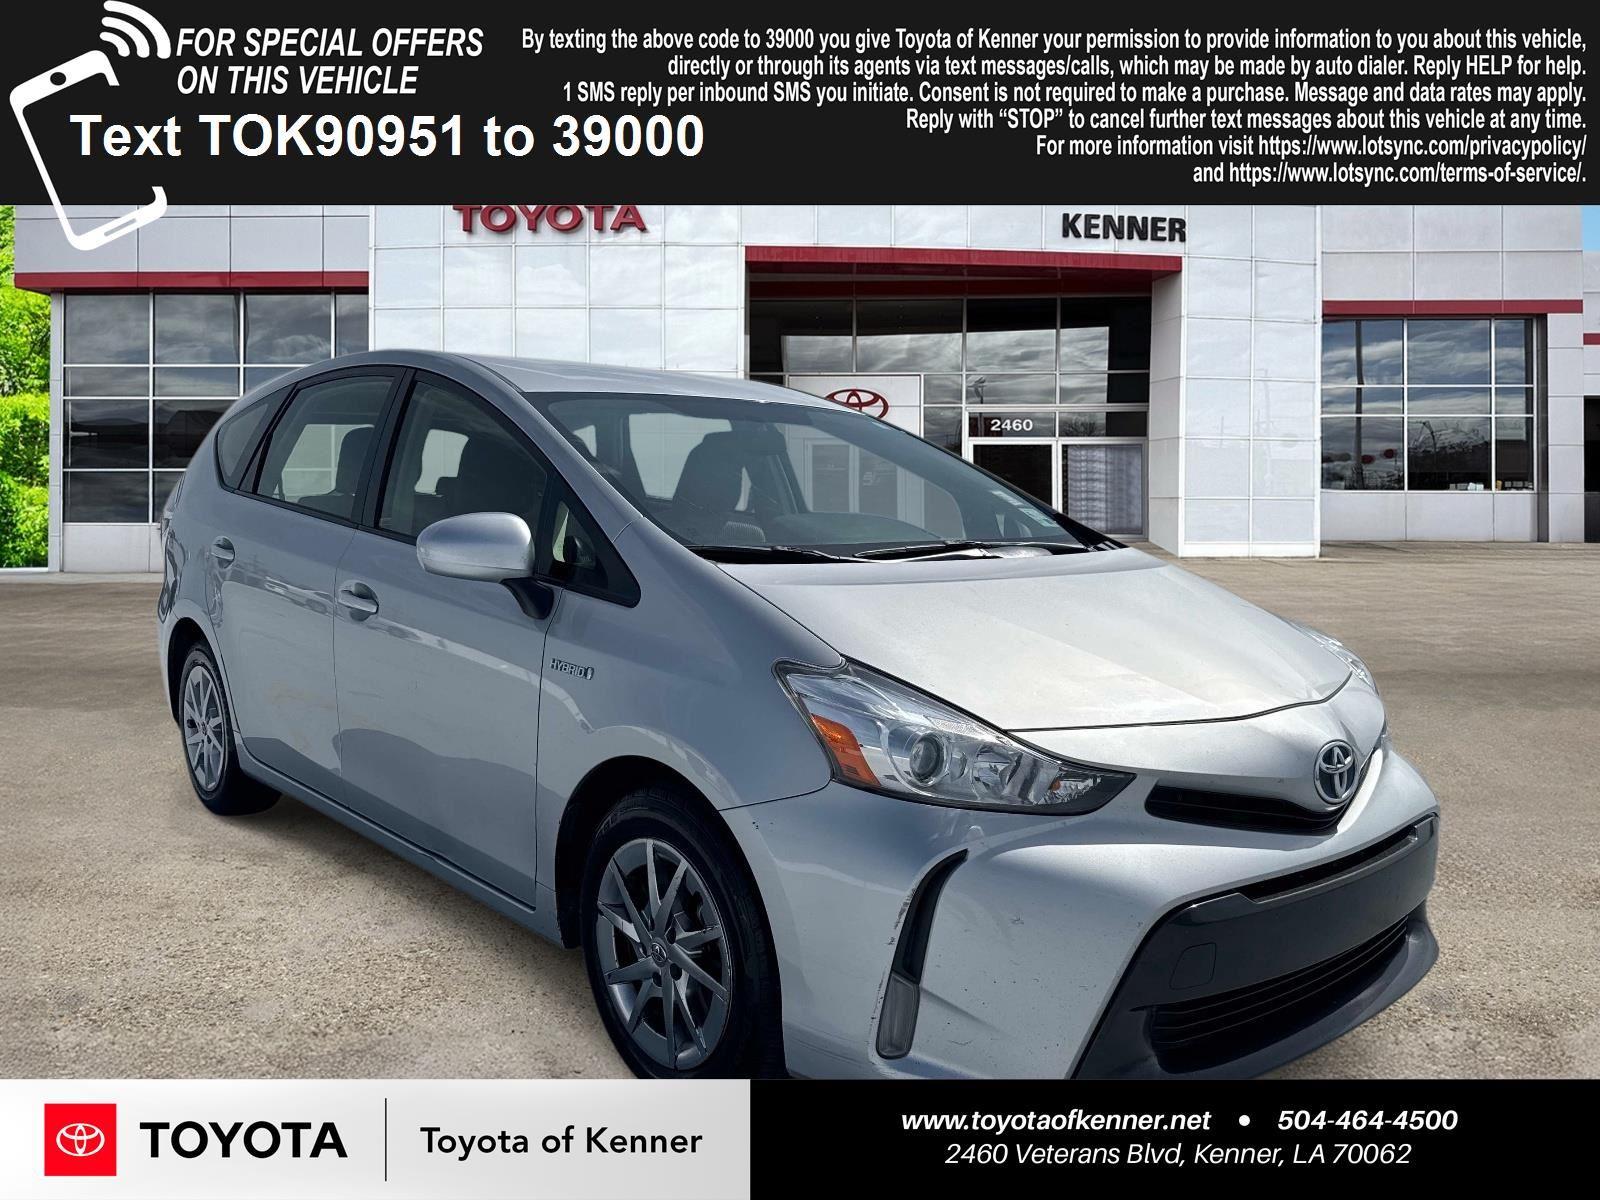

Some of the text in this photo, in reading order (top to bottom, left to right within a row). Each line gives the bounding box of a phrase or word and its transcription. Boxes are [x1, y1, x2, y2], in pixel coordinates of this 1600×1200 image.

[452, 205, 647, 232] TOYOTA
[1062, 213, 1187, 242] KENNER
[990, 419, 1033, 431] 2460
[550, 657, 586, 678] HYBRID
